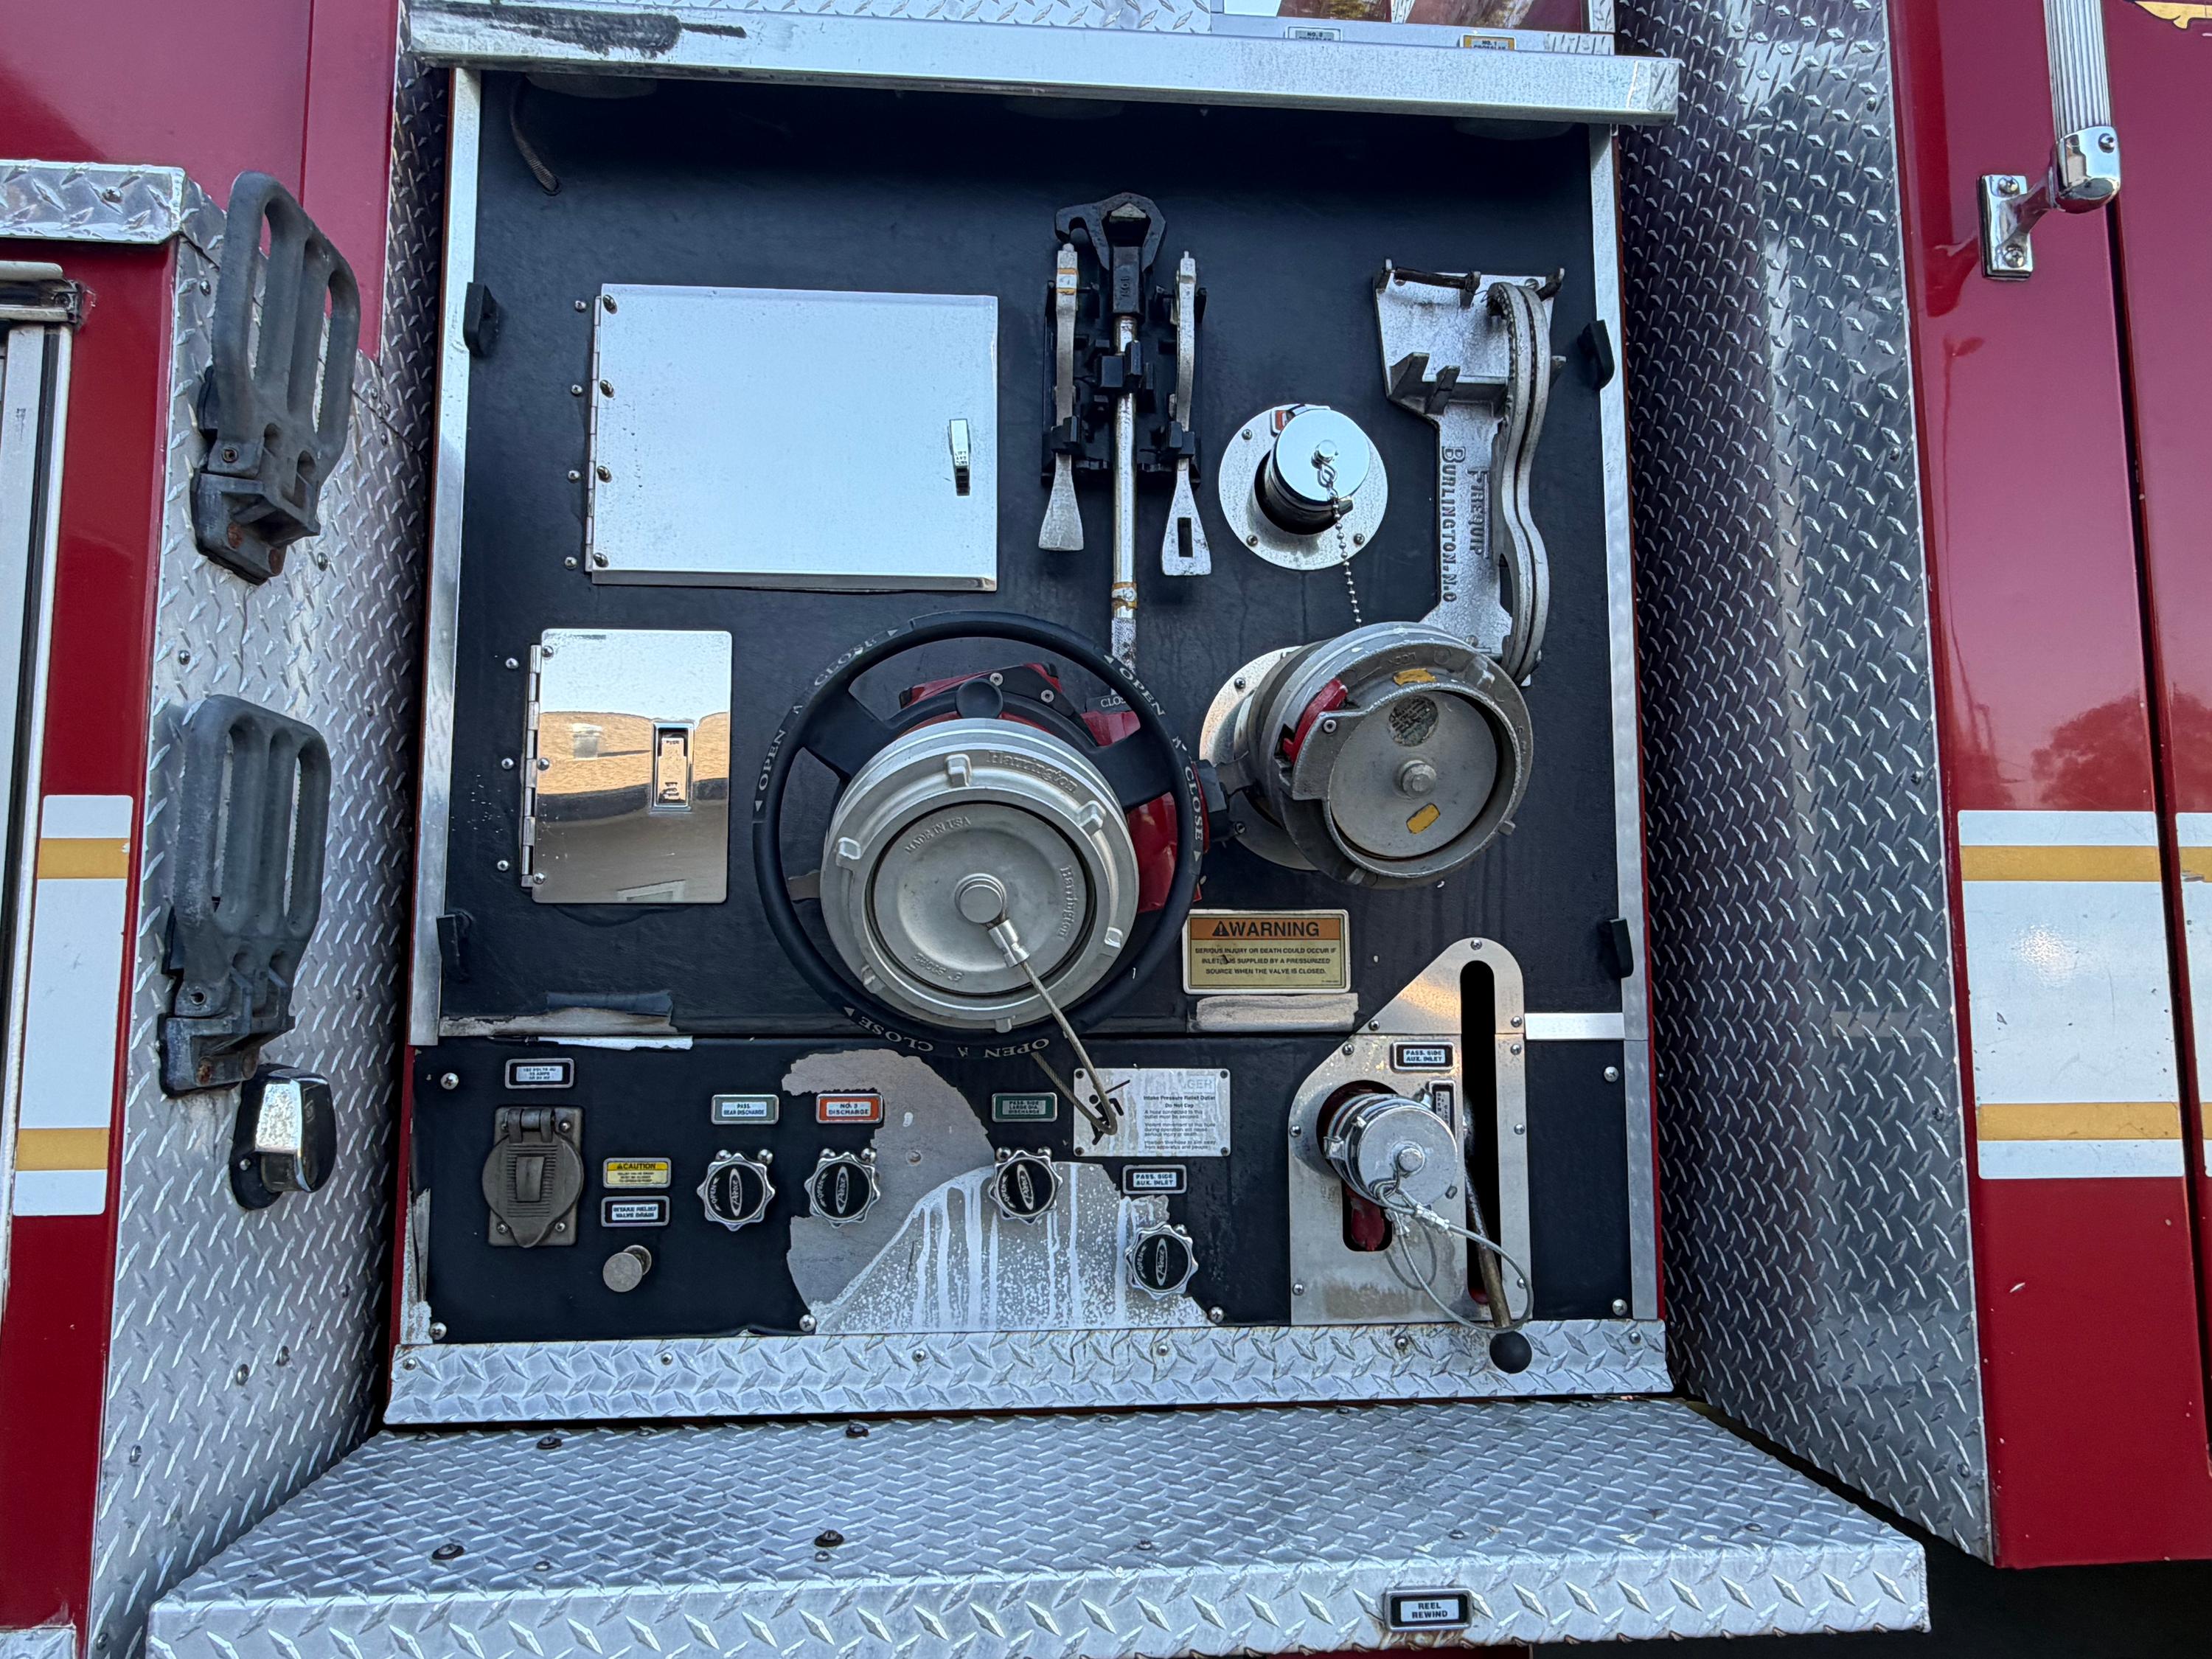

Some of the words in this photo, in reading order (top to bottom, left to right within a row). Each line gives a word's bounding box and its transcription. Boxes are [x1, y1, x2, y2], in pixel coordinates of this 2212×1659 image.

[1100, 696, 1127, 708] CLOS
[1119, 667, 1166, 716] OPEN
[758, 729, 787, 791] OPEN
[1185, 765, 1205, 841] CLOSE
[1229, 922, 1320, 936] WARNING
[858, 1016, 933, 1052] CLOSE
[984, 1038, 1049, 1059] OPEN
[710, 1185, 718, 1204] OPEN
[1412, 1610, 1448, 1618] REWIND
